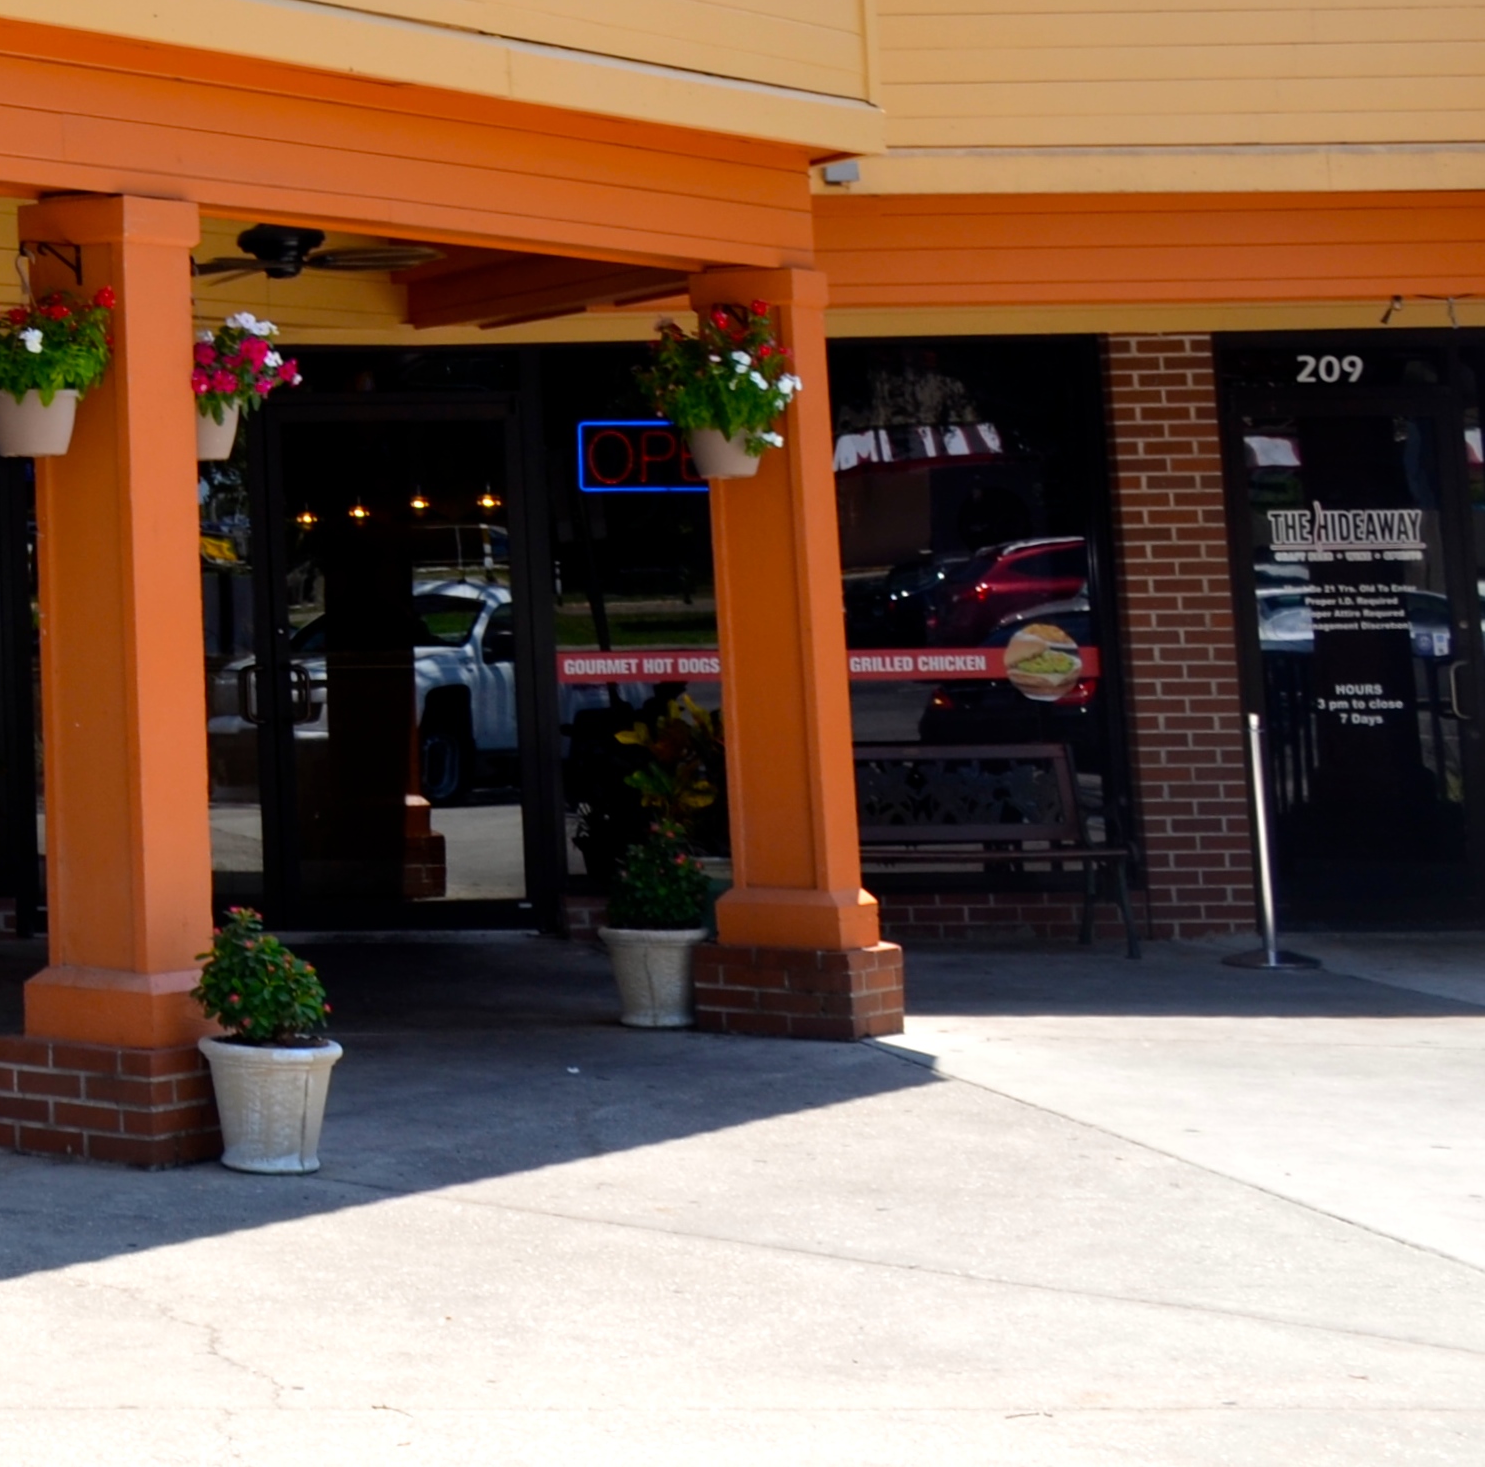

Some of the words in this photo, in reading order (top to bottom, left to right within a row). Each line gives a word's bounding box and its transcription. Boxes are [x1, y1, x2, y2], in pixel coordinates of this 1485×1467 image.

[1296, 354, 1364, 384] 209
[587, 429, 708, 485] OPE
[1267, 509, 1312, 545] THE
[1312, 499, 1422, 546] HIDEAWAY
[1359, 584, 1375, 593] Old
[1377, 584, 1389, 593] To
[1356, 596, 1399, 607] Required
[563, 658, 639, 675] GOURMET
[642, 657, 674, 674] HOT
[677, 657, 720, 674] DOGS
[849, 656, 913, 673] GRILLED
[916, 655, 987, 672] CHICKEN
[1335, 683, 1383, 695] HOURS
[1317, 699, 1325, 710] 3
[1328, 701, 1350, 712] pm
[1352, 699, 1366, 710] to
[1368, 699, 1404, 710] close
[1340, 713, 1349, 724] 7
[1351, 713, 1384, 727] Days
